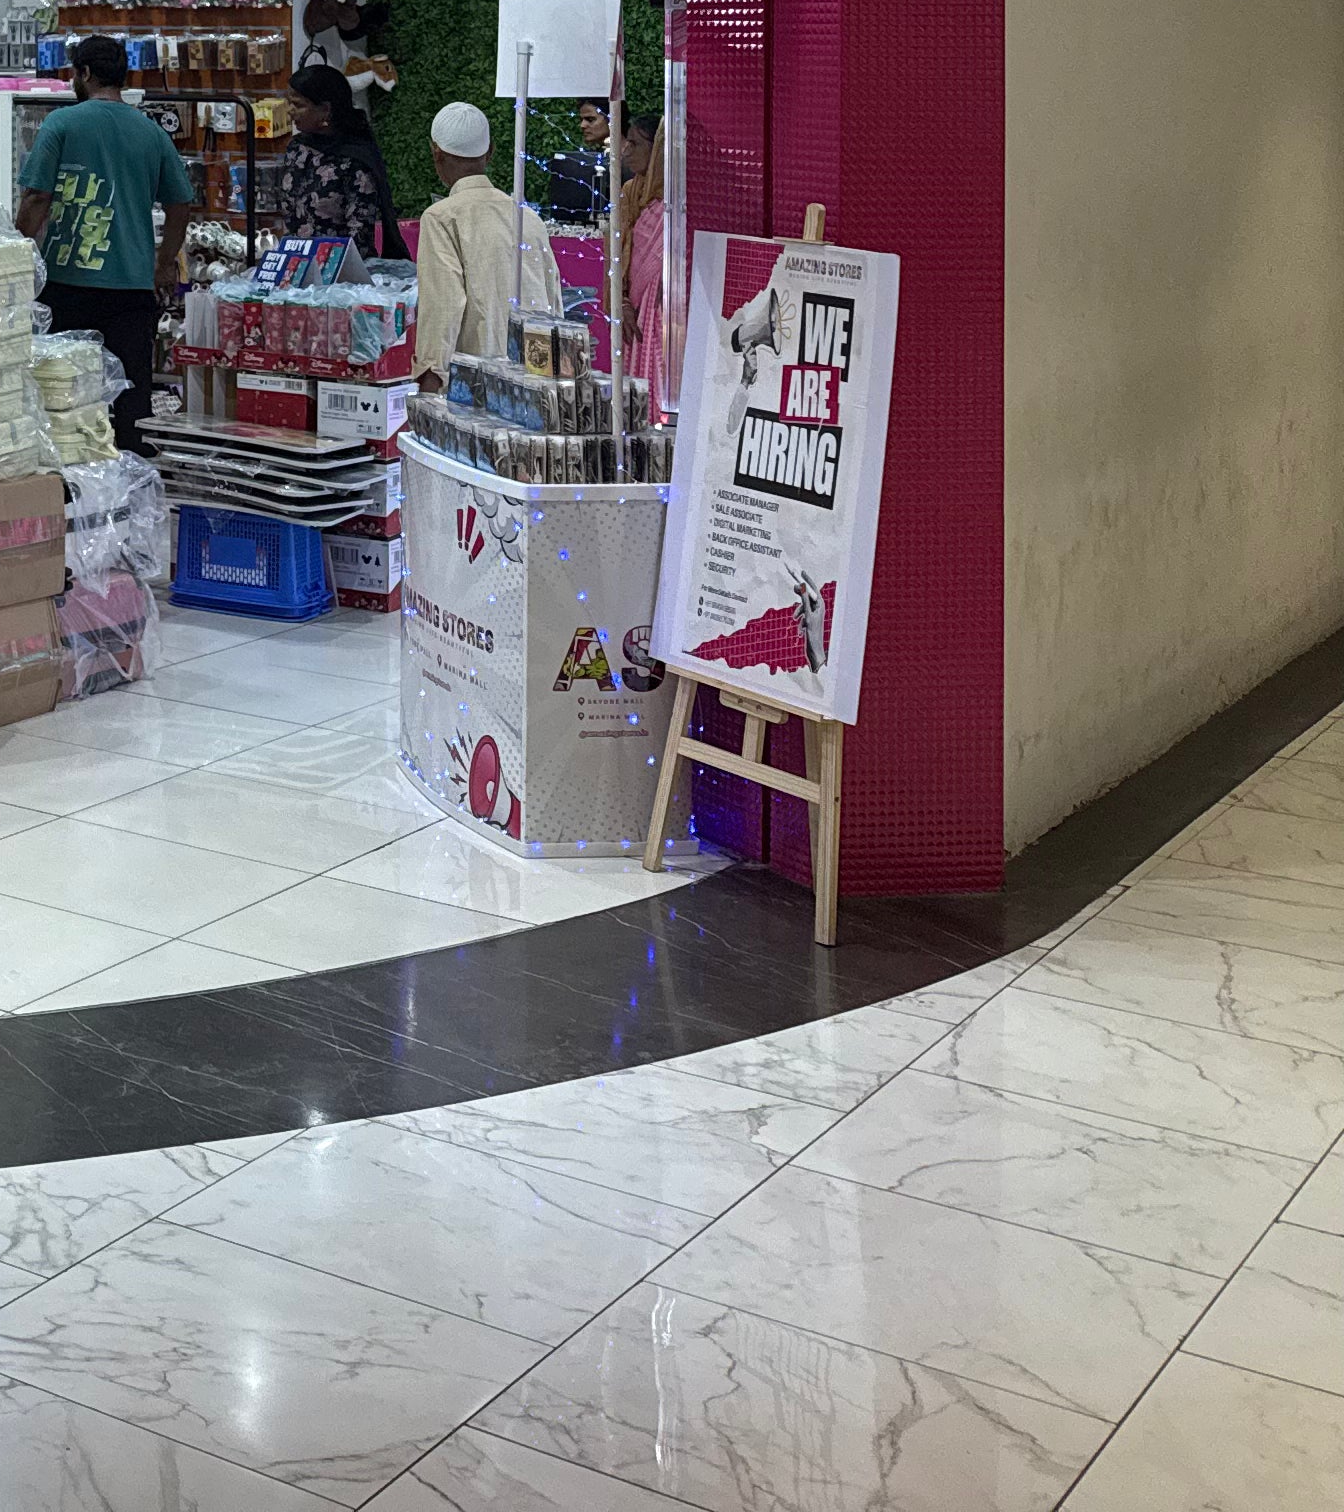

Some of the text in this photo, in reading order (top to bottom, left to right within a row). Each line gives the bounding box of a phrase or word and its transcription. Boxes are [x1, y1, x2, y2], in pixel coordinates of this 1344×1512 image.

[284, 239, 305, 251] BUY
[262, 262, 277, 271] GET
[265, 252, 280, 261] BUY
[257, 271, 278, 280] FREE
[784, 255, 863, 280] AMAZING STORES
[803, 302, 850, 369] WE
[177, 346, 199, 358] Disney
[243, 351, 265, 363] Disney
[310, 357, 333, 371] Disney
[785, 368, 832, 420] ARE
[738, 415, 838, 497] HIRING
[717, 489, 780, 513] ASSOCIATE MANAGER
[715, 503, 763, 524] SALE ASSOCIATE
[714, 517, 772, 540] DIGITAL MARKETING
[712, 532, 783, 559] BACK OFFICE ASSISTANT
[707, 561, 737, 577] SECURITY
[442, 609, 494, 654] STORES
[552, 625, 666, 693] AS
[469, 676, 488, 690] MALL
